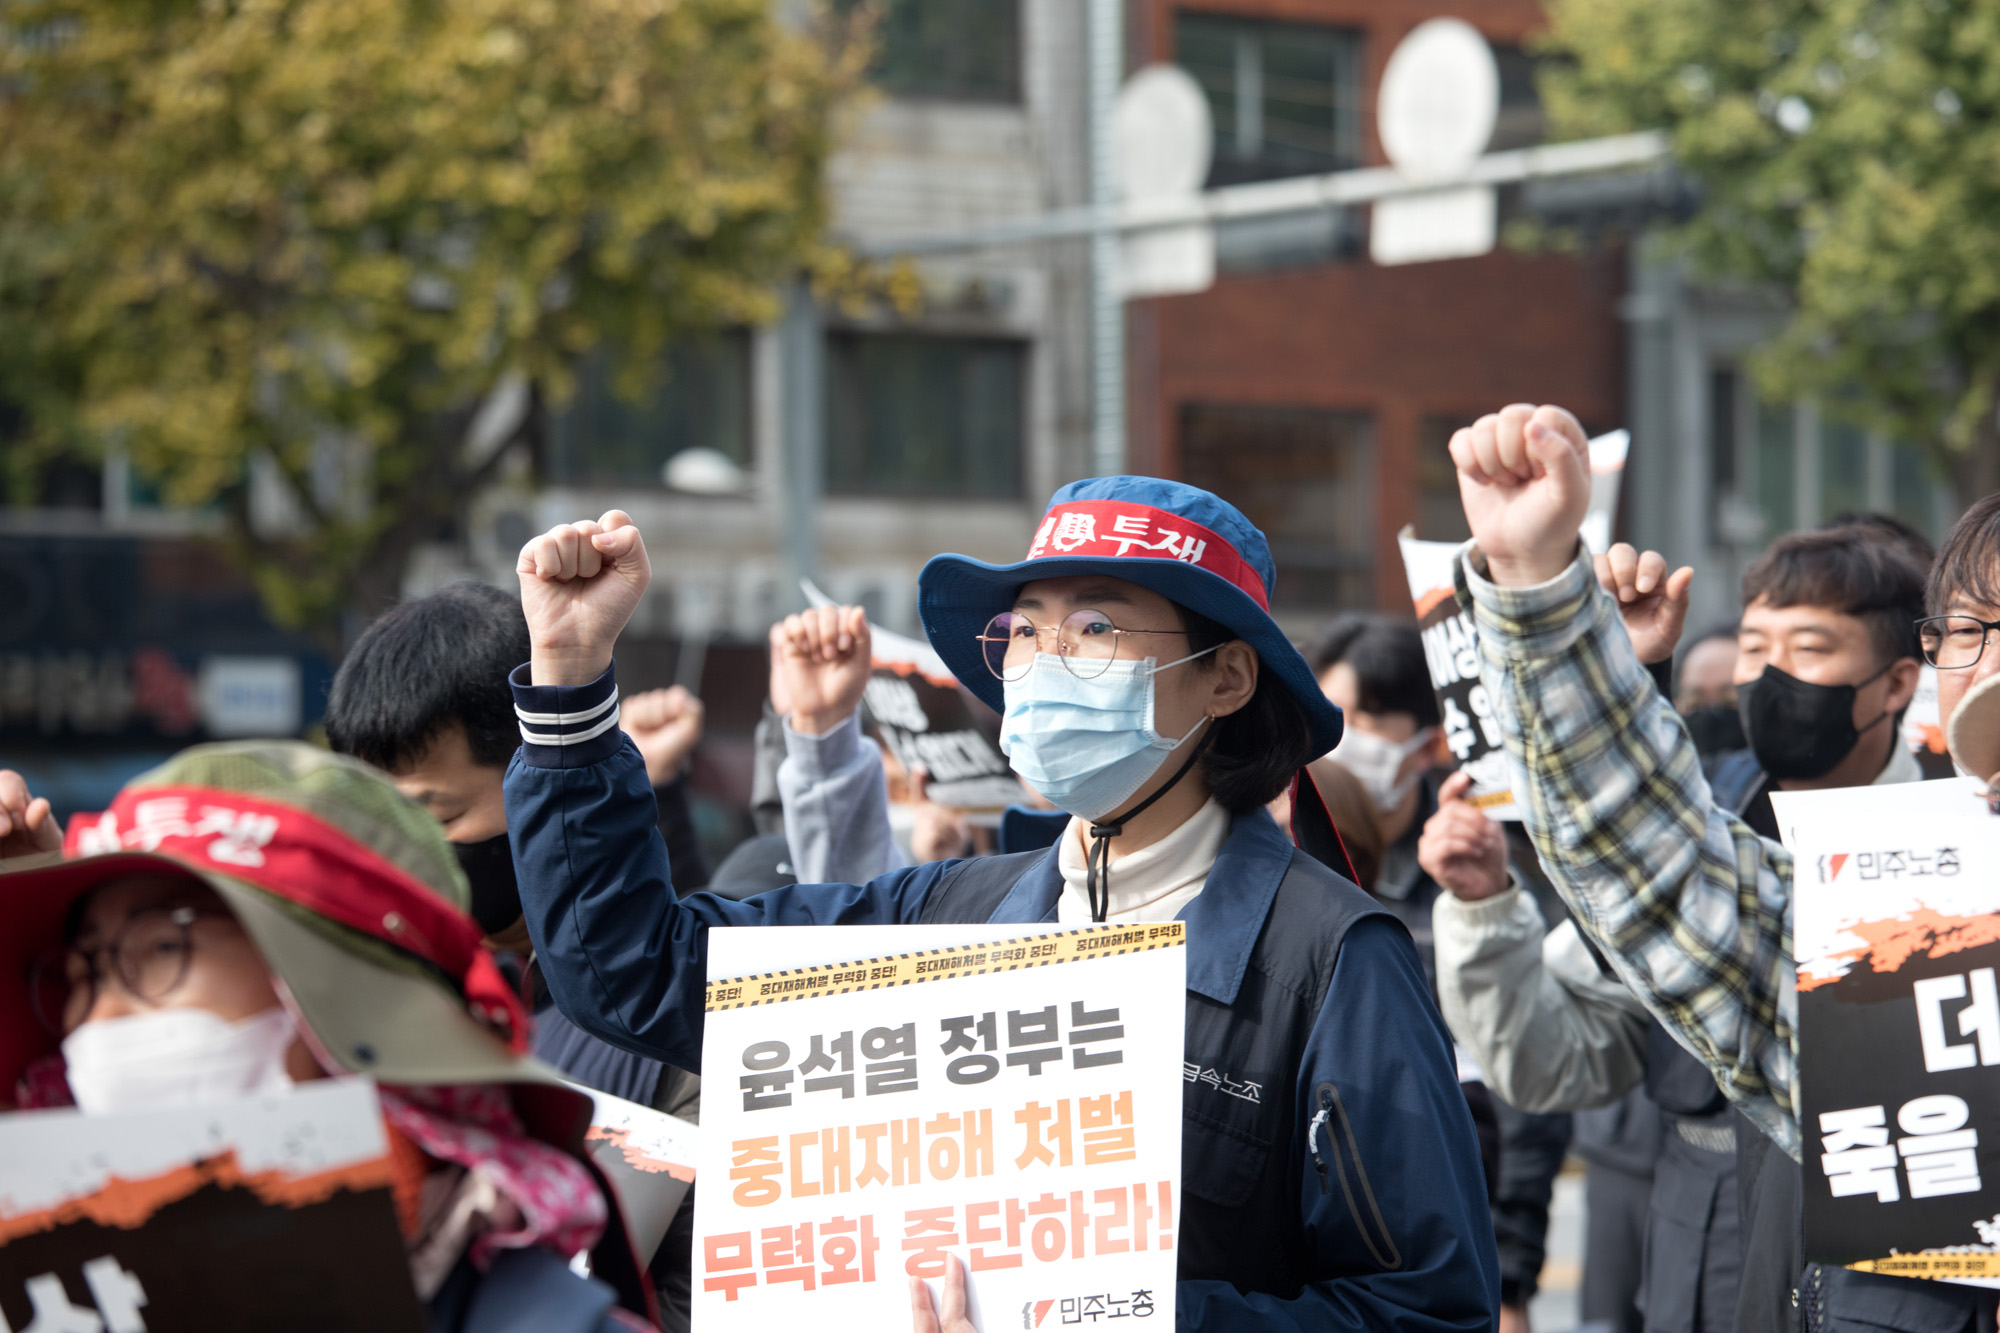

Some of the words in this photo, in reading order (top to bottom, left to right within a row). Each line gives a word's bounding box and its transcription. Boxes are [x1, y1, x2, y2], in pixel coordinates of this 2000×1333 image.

[1857, 847, 1960, 880] 민주노총
[715, 987, 742, 1002] 중단!
[760, 975, 829, 996] 중대재해처벌
[833, 970, 867, 985] 무력화
[870, 965, 897, 980] 중단!
[915, 951, 985, 974] 중대재해처벌
[990, 945, 1026, 963] 무력화
[1030, 943, 1057, 958] 중단!
[1076, 930, 1145, 952] 중대재해처벌
[1149, 924, 1182, 941] 무력화
[739, 1022, 919, 1112] 윤석열
[940, 1000, 1125, 1085] 정부는
[729, 1107, 995, 1207] 중대재해
[1014, 1090, 1137, 1171] 처벌
[1819, 1094, 1983, 1203] 죽을
[703, 1214, 880, 1302] 무력화
[901, 1180, 1174, 1279] 중단하라!
[1060, 1289, 1154, 1324] 민주노총
